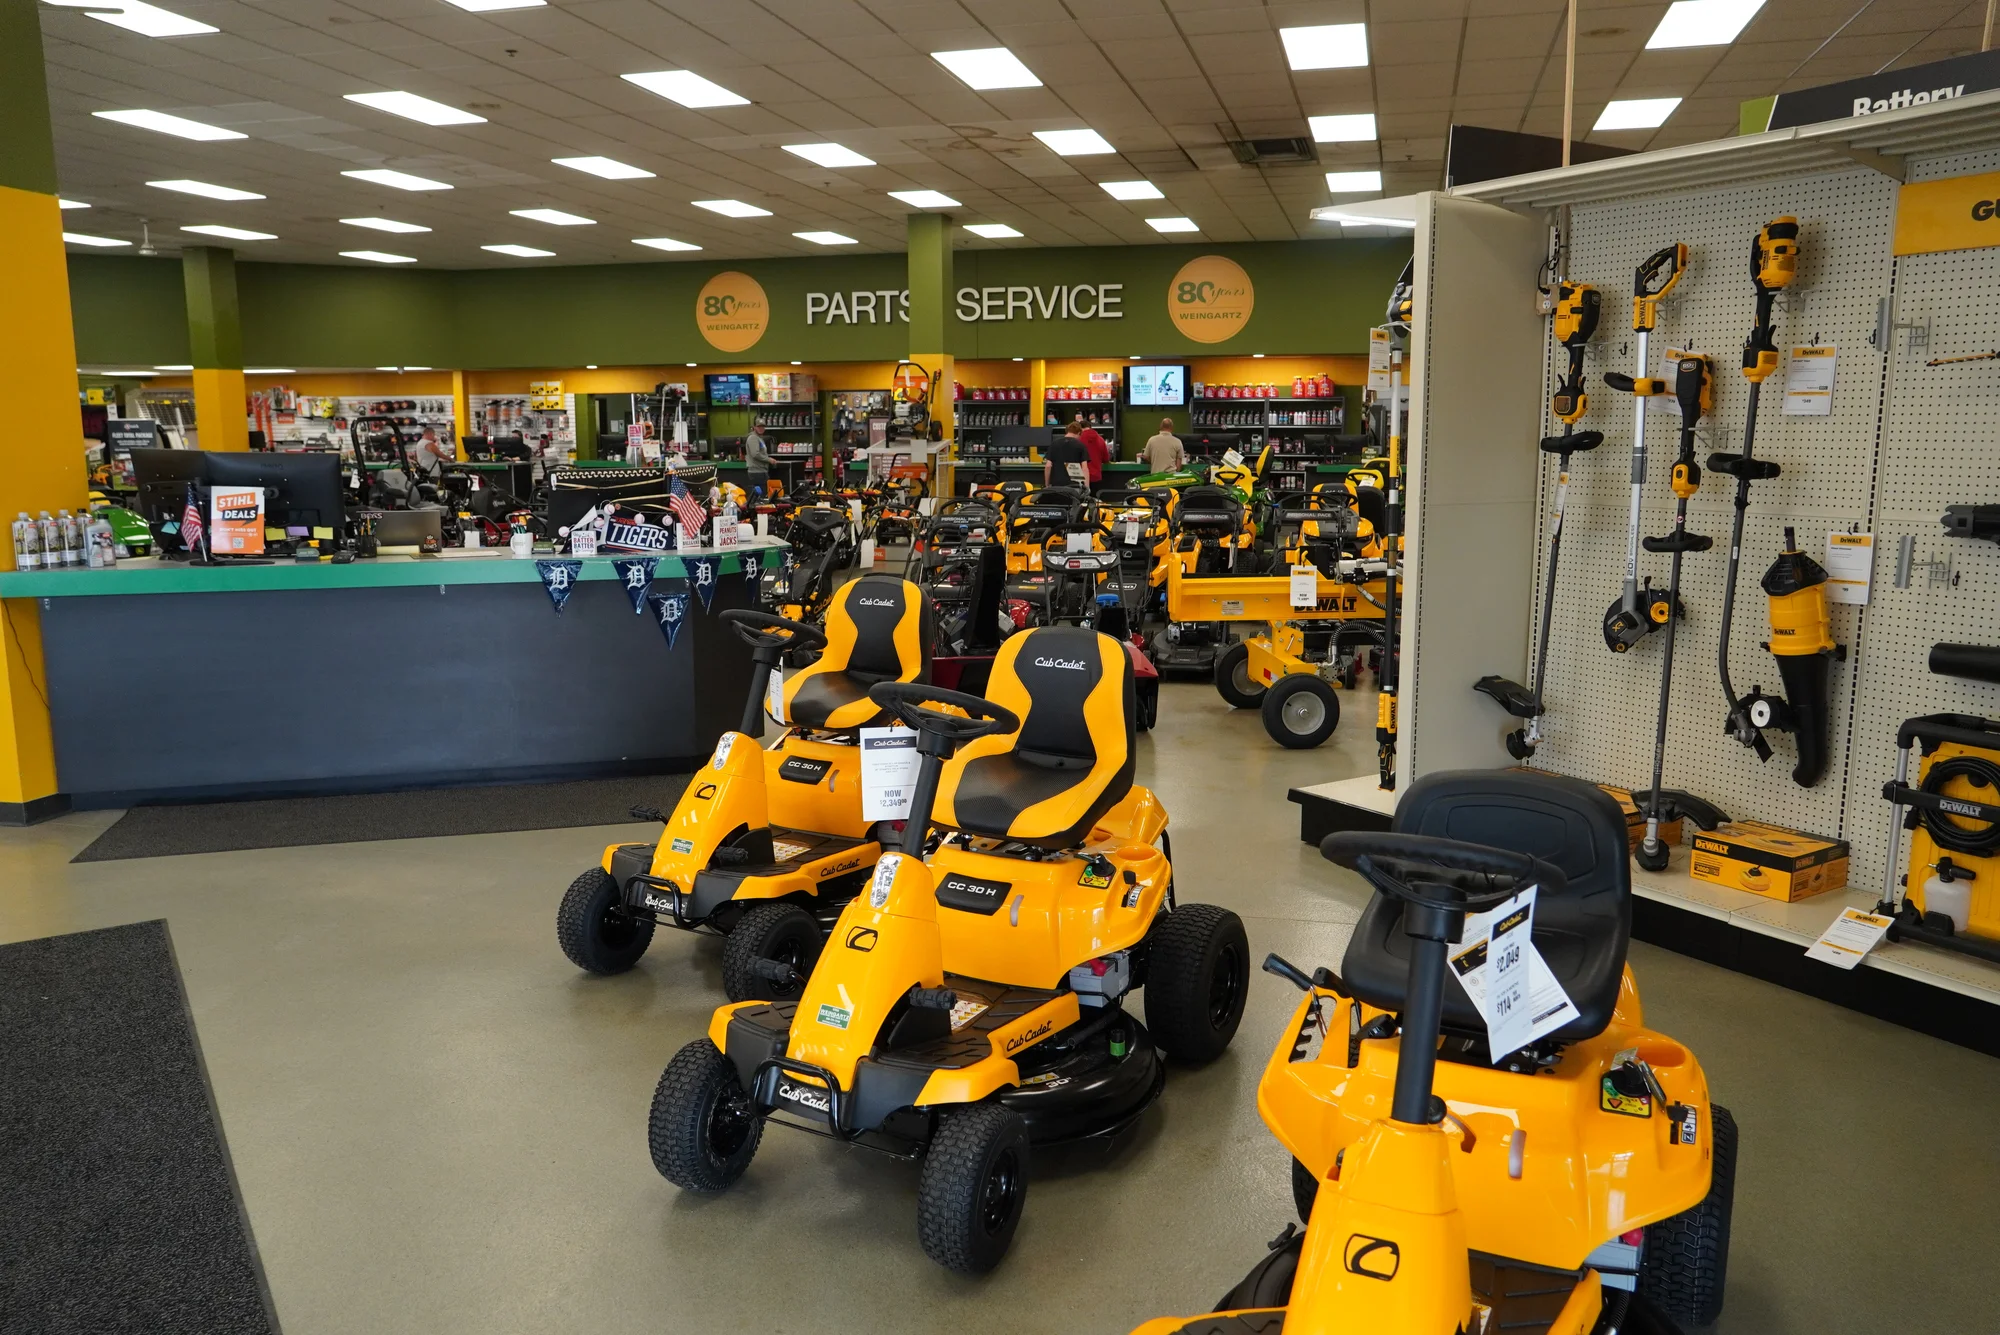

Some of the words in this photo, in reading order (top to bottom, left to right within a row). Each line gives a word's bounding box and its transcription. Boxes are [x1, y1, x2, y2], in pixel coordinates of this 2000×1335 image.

[1853, 84, 1965, 117] Battery
[1177, 281, 1215, 304] 80
[704, 295, 735, 316] 80
[956, 284, 1123, 321] SERVICE
[706, 323, 760, 331] WEINGARTZ
[218, 495, 254, 508] STIHL
[224, 509, 256, 519] DEALS
[610, 522, 669, 549] TIGERS
[720, 526, 737, 534] PEANUTS
[720, 537, 737, 546] JACKS
[549, 565, 569, 590] D
[627, 563, 646, 590] D
[696, 562, 712, 588] D
[660, 599, 679, 624] D
[859, 598, 873, 606] Cub
[873, 598, 895, 607] Cadet
[1034, 657, 1054, 667] Cub
[1054, 658, 1087, 671] Cadet
[884, 790, 902, 798] NOW
[1940, 799, 1981, 818] DEWALT
[1695, 839, 1729, 855] DEWALT
[820, 864, 836, 877] Cub
[836, 858, 861, 872] Cadet
[947, 882, 966, 890] CC
[967, 885, 985, 894] 30
[985, 888, 997, 896] H
[645, 896, 659, 906] Cub
[1496, 946, 1520, 972] $2,049
[820, 1008, 850, 1021] WEINGARTZ
[1496, 995, 1511, 1016] $114
[1006, 1034, 1024, 1052] Cub
[1024, 1020, 1052, 1043] Cadet
[1045, 1077, 1072, 1088] 30"
[779, 1085, 800, 1101] Cub
[800, 1092, 829, 1112] Cade
